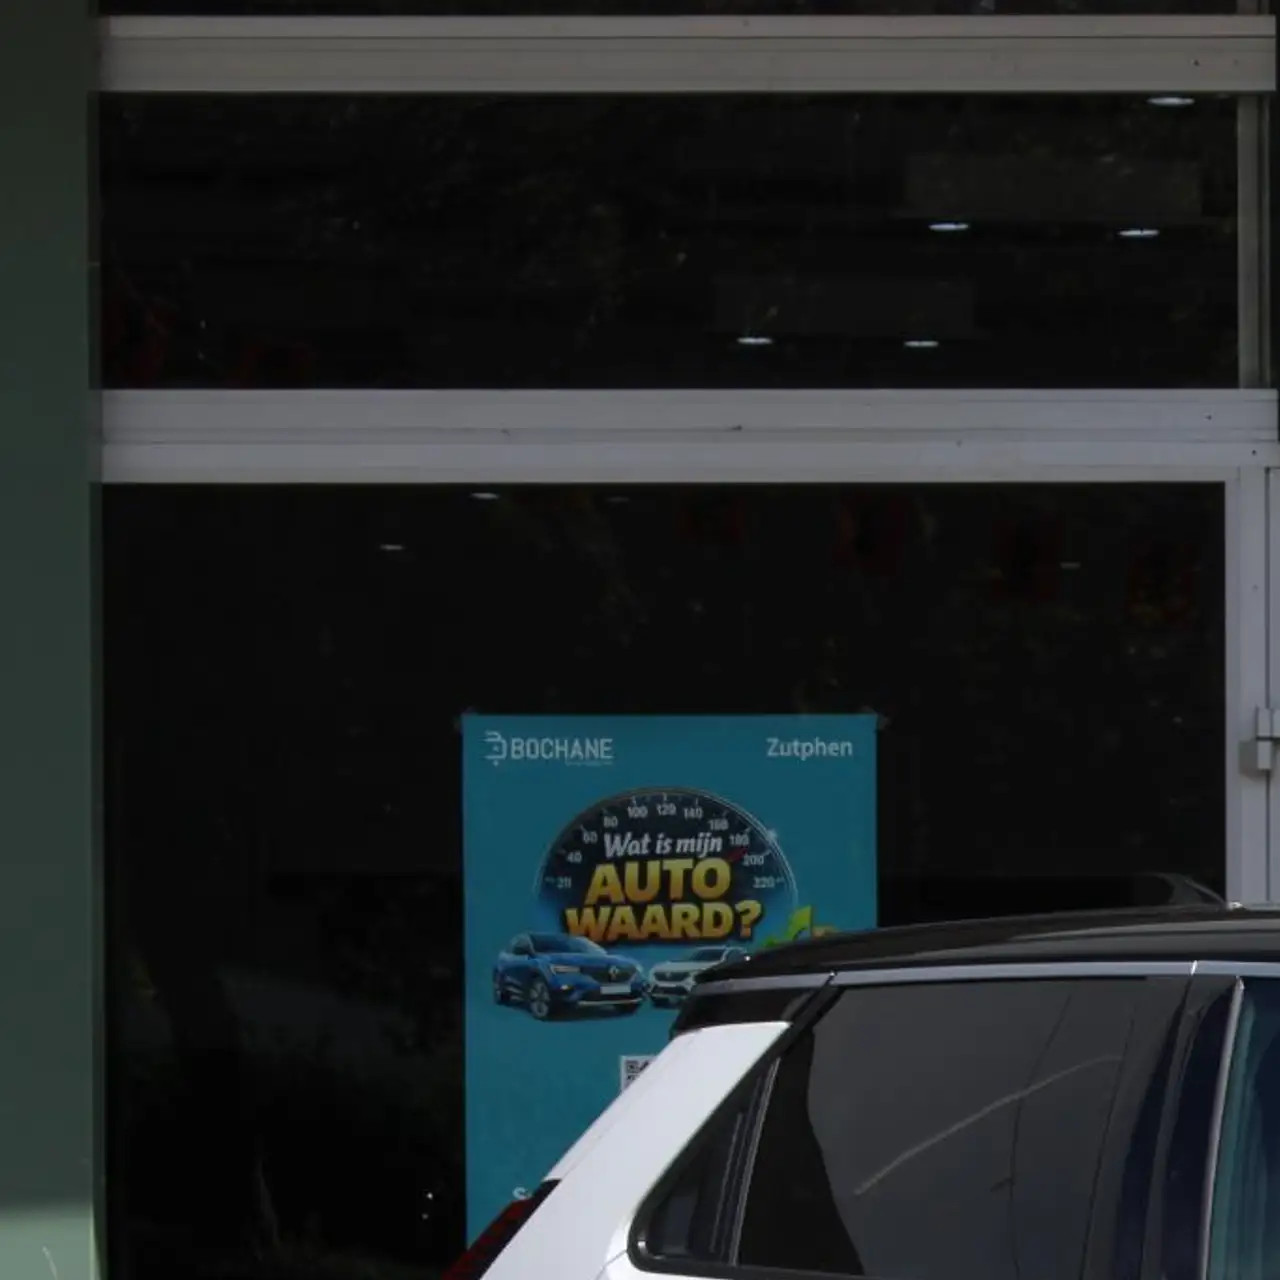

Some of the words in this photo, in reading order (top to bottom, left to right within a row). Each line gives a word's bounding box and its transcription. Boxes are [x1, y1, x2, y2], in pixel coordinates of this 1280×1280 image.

[510, 737, 614, 760] BOCHANE
[766, 737, 853, 762] Zutphen
[627, 805, 649, 818] 100
[656, 803, 677, 816] 120
[683, 808, 704, 819] 140
[603, 833, 650, 858] Wat
[655, 834, 673, 854] is
[676, 832, 723, 859] mijn
[586, 858, 731, 904] AUTO
[566, 901, 761, 940] WAARD?
